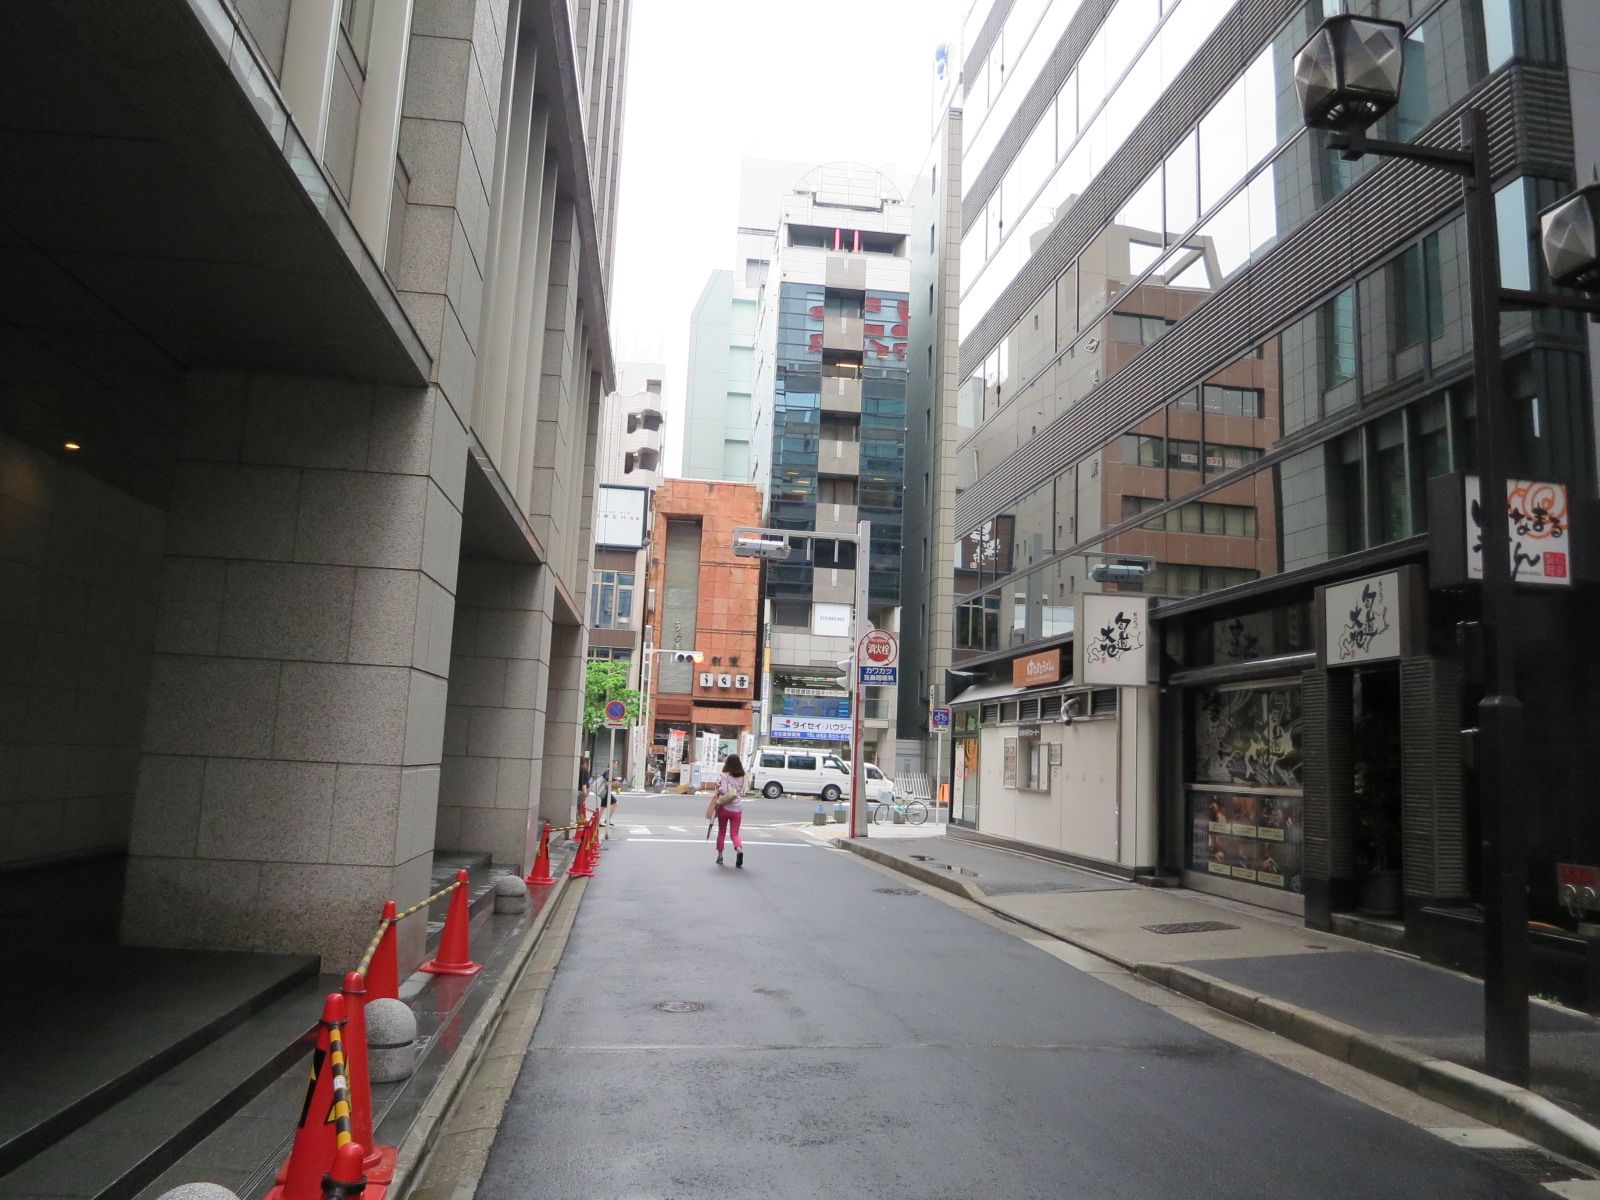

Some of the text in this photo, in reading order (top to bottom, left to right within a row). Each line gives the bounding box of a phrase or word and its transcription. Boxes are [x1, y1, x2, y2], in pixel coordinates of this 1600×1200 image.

[867, 643, 890, 655] 消火栓
[865, 667, 893, 675] カワカツ
